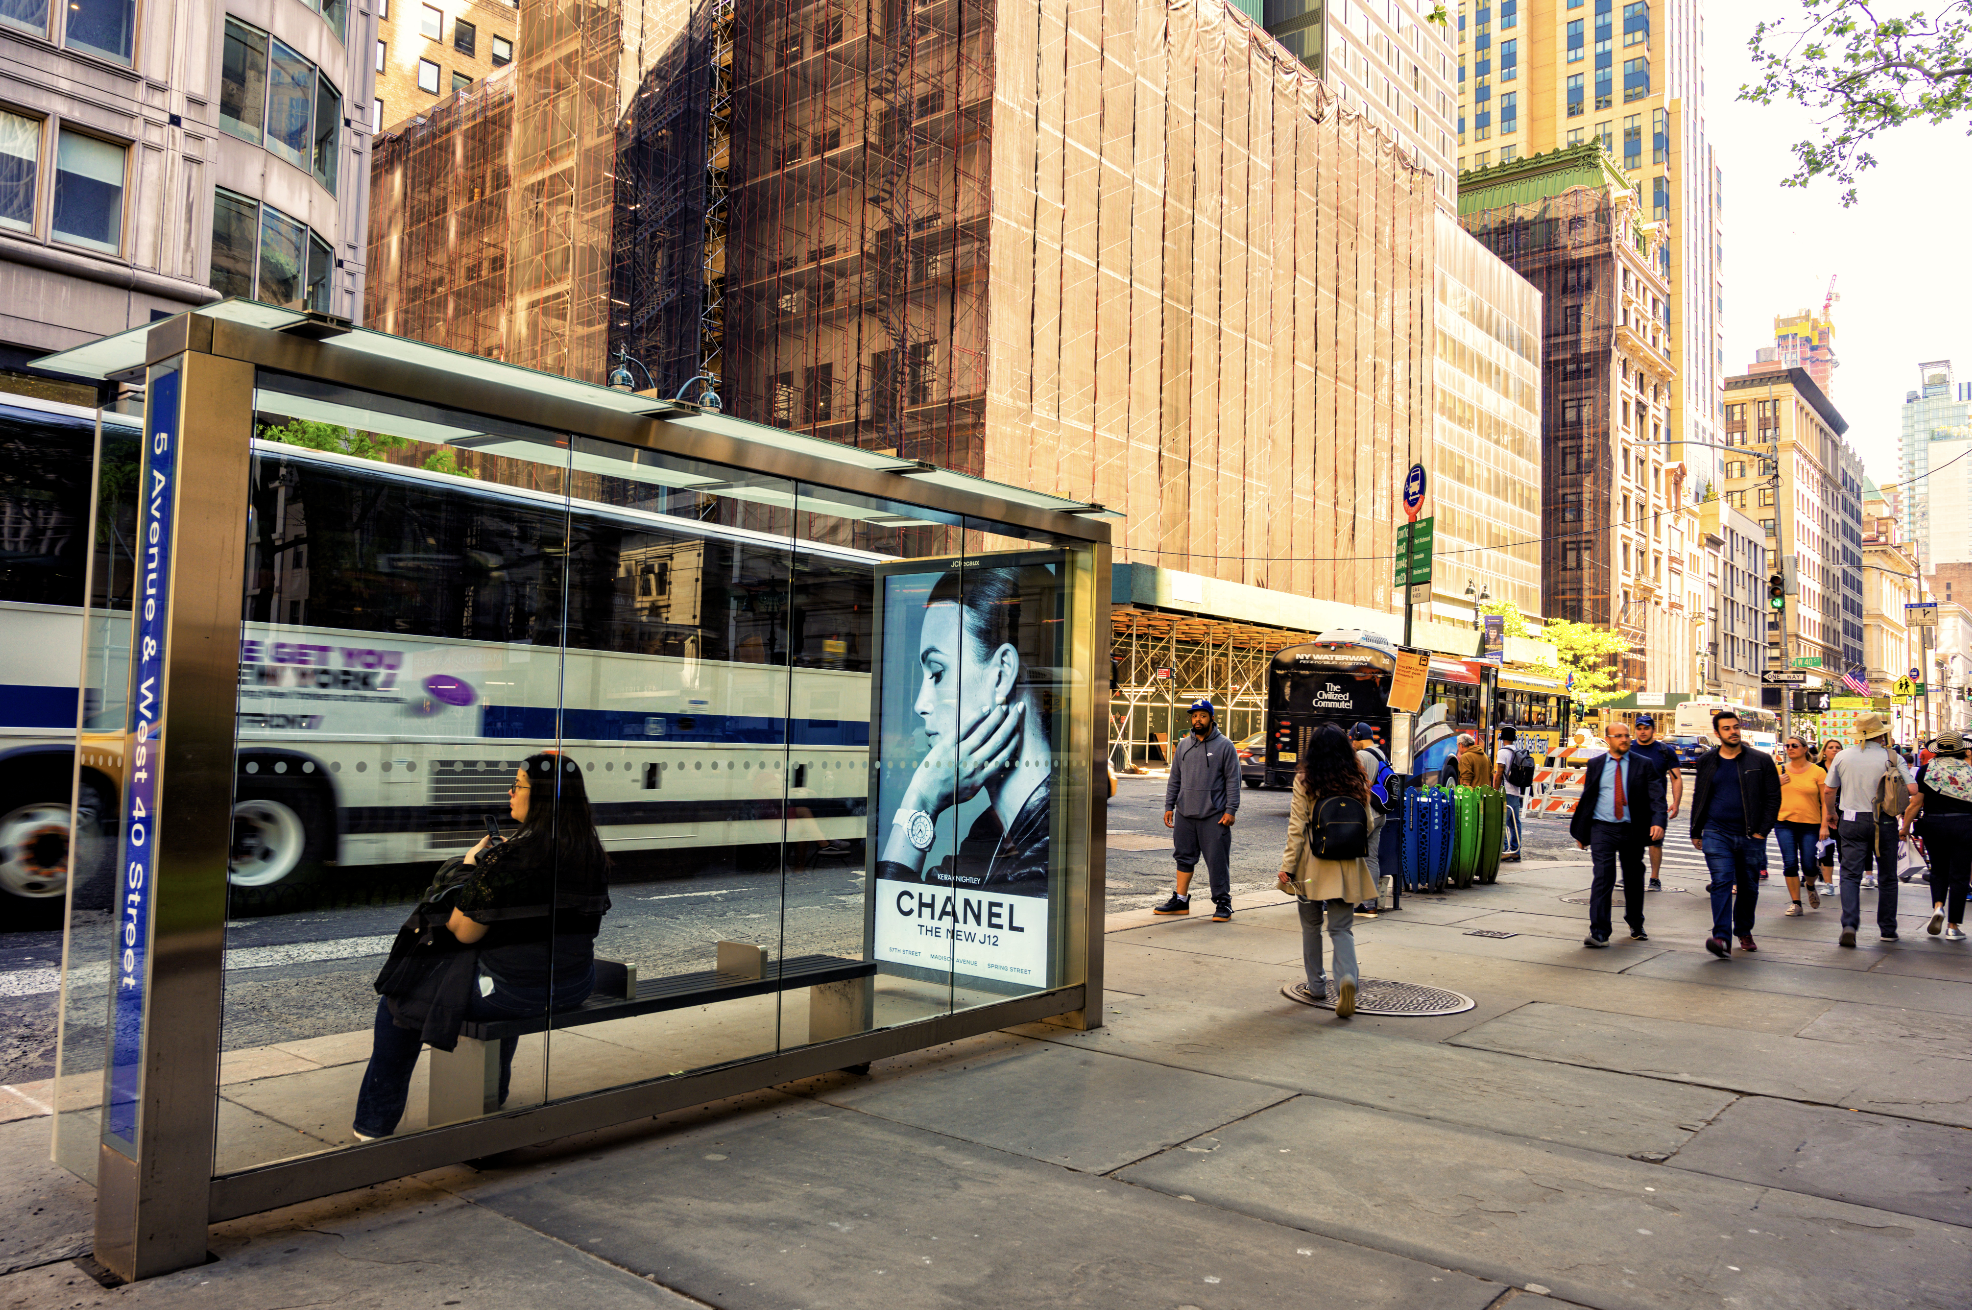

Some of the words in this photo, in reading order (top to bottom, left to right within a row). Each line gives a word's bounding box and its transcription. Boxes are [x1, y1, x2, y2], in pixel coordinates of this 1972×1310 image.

[154, 432, 168, 455] 5
[144, 468, 166, 622] Avenue
[142, 635, 157, 665] &
[1312, 654, 1373, 662] WATERWAY
[1316, 690, 1350, 700] Civilized
[1325, 682, 1341, 692] The
[134, 676, 155, 783] West
[130, 796, 146, 848] 40
[896, 890, 1025, 933] CHANEL
[122, 861, 143, 990] Street
[918, 924, 941, 938] THE
[946, 928, 977, 943] NEW
[979, 934, 999, 946] J12
[902, 948, 921, 957] STREET
[956, 958, 978, 966] AVENUE
[987, 963, 1008, 972] SPRING
[1010, 966, 1032, 975] STREET
